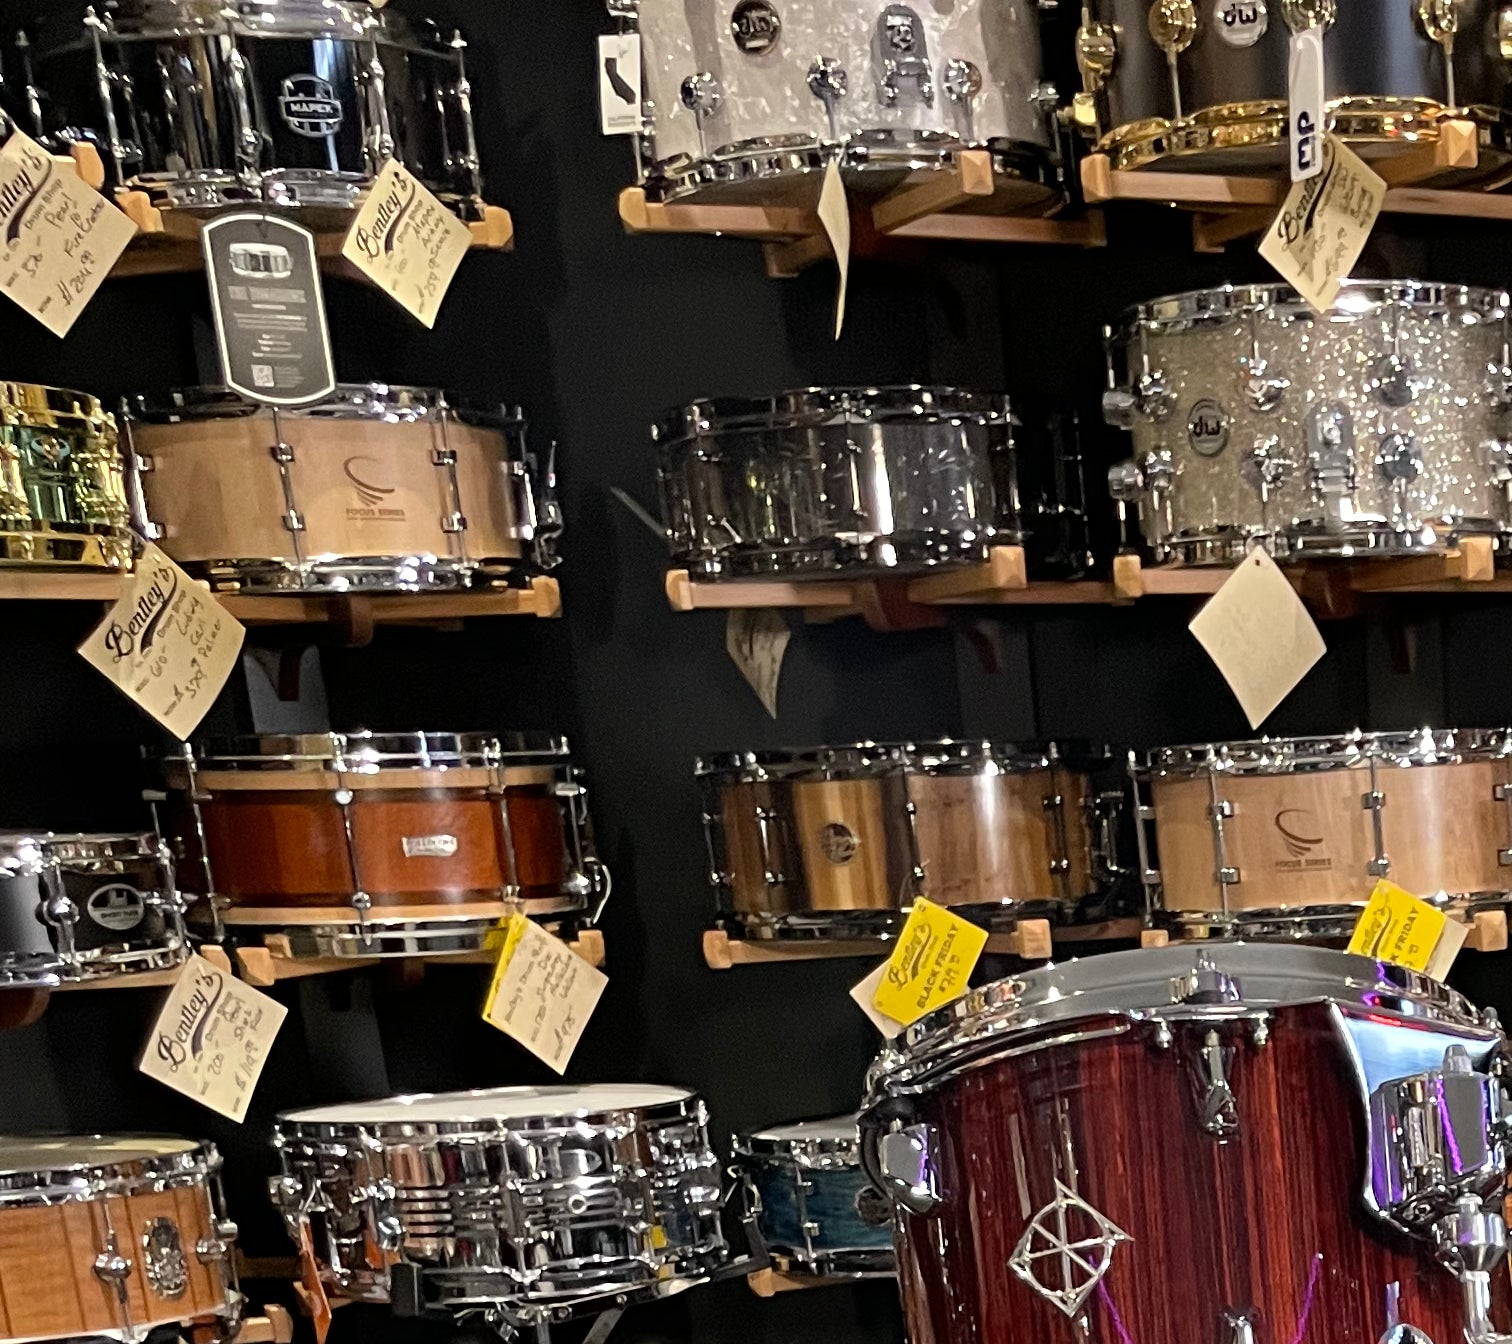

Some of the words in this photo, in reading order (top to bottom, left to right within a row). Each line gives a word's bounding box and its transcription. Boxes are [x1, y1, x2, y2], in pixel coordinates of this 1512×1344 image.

[357, 180, 409, 258] Bentley's
[1194, 416, 1220, 437] dw
[104, 567, 171, 664] Bentley's
[916, 968, 938, 1009] BLACK
[934, 922, 959, 968] FRIDAY
[158, 971, 217, 1073] Bentley's
